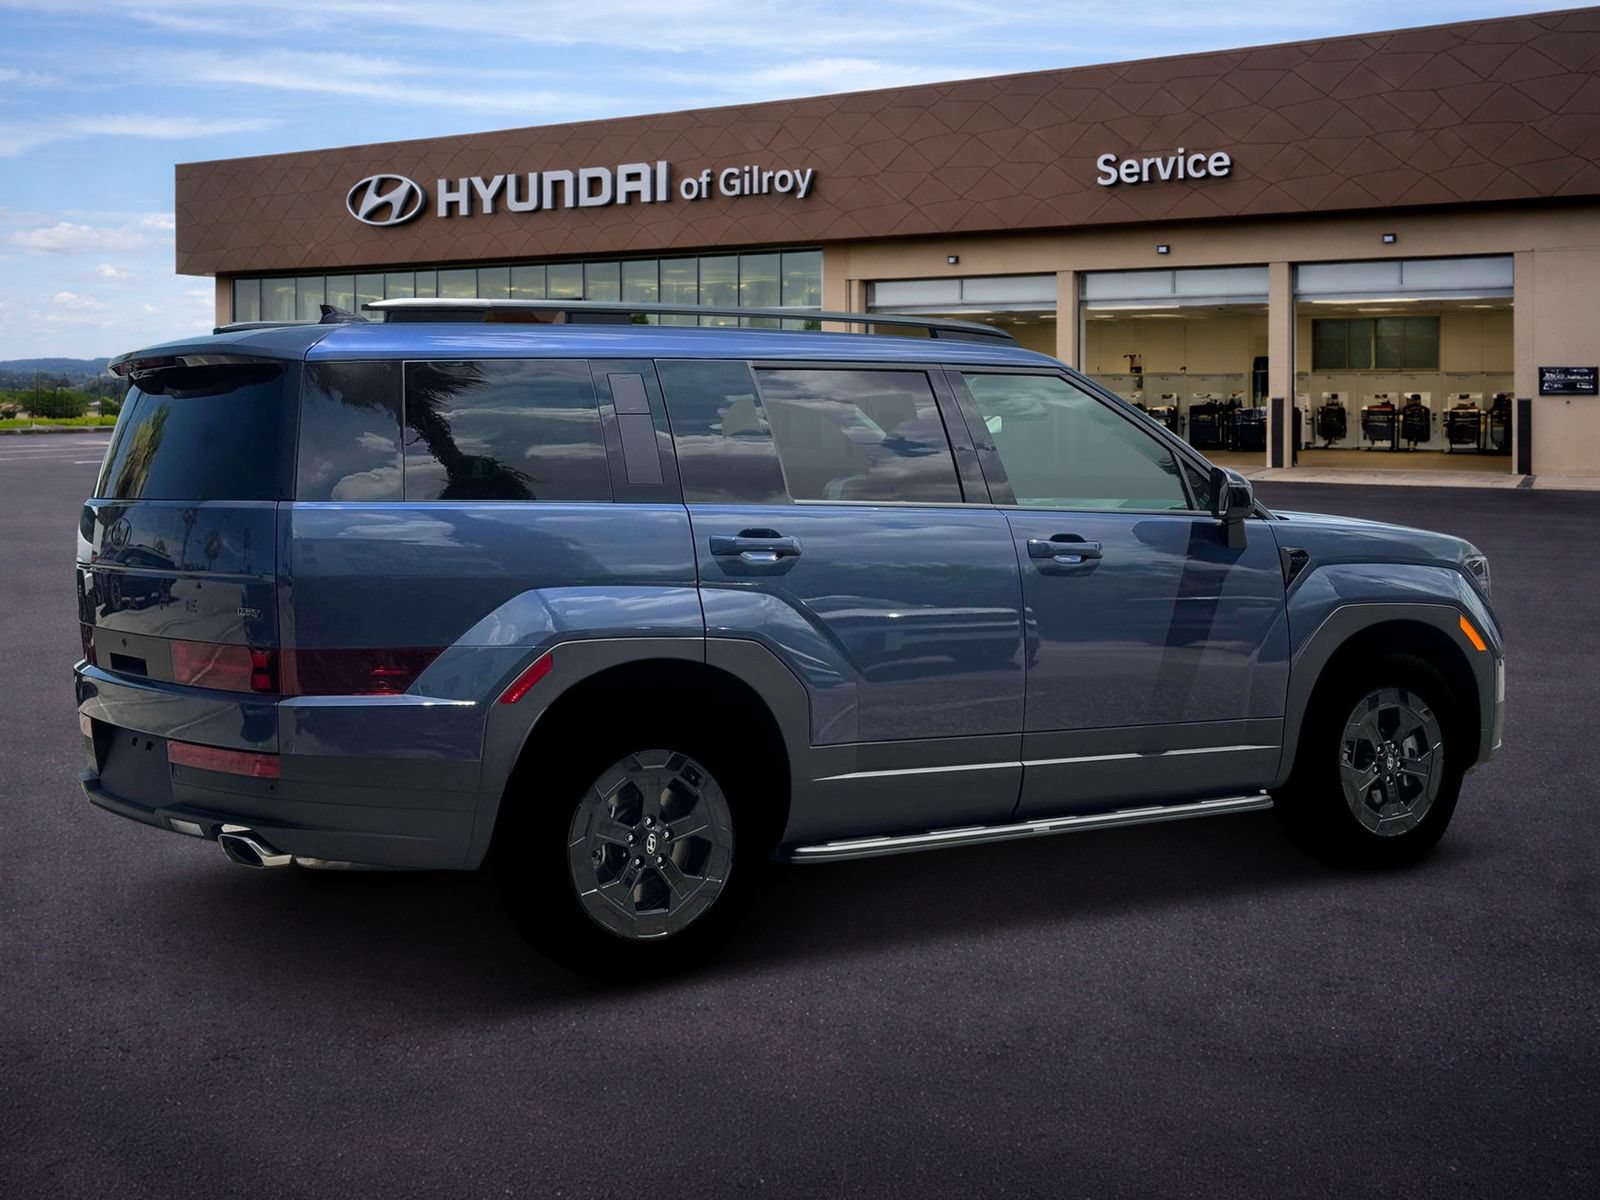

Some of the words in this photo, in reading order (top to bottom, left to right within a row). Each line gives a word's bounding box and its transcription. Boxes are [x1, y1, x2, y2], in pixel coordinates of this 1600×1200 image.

[437, 160, 669, 217] HYUNDAI
[680, 169, 712, 200] of
[719, 165, 813, 199] Gilroy
[1096, 147, 1231, 186] Service
